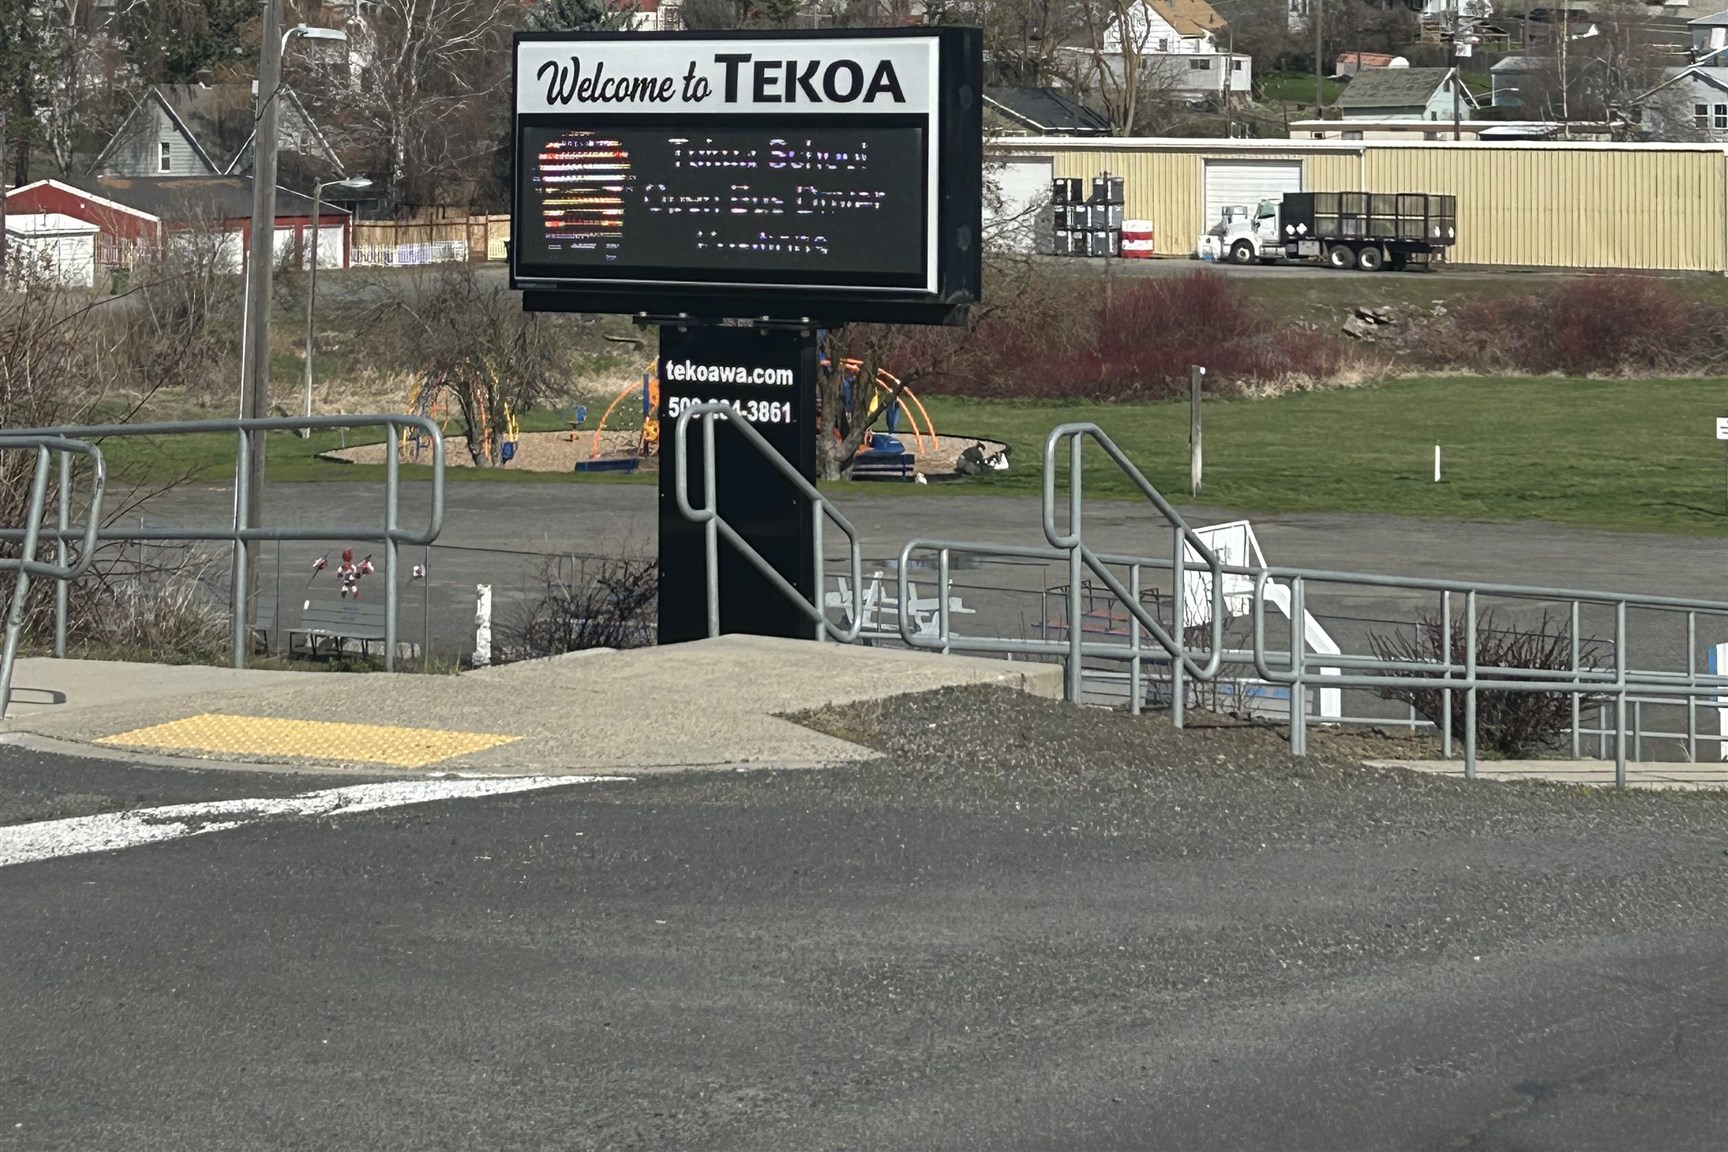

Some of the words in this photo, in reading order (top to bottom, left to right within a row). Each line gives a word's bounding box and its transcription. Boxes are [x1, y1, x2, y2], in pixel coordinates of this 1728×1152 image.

[537, 57, 676, 106] Welcome
[681, 60, 713, 103] to
[714, 53, 907, 103] TEKOA
[666, 359, 794, 386] tekoawa.com
